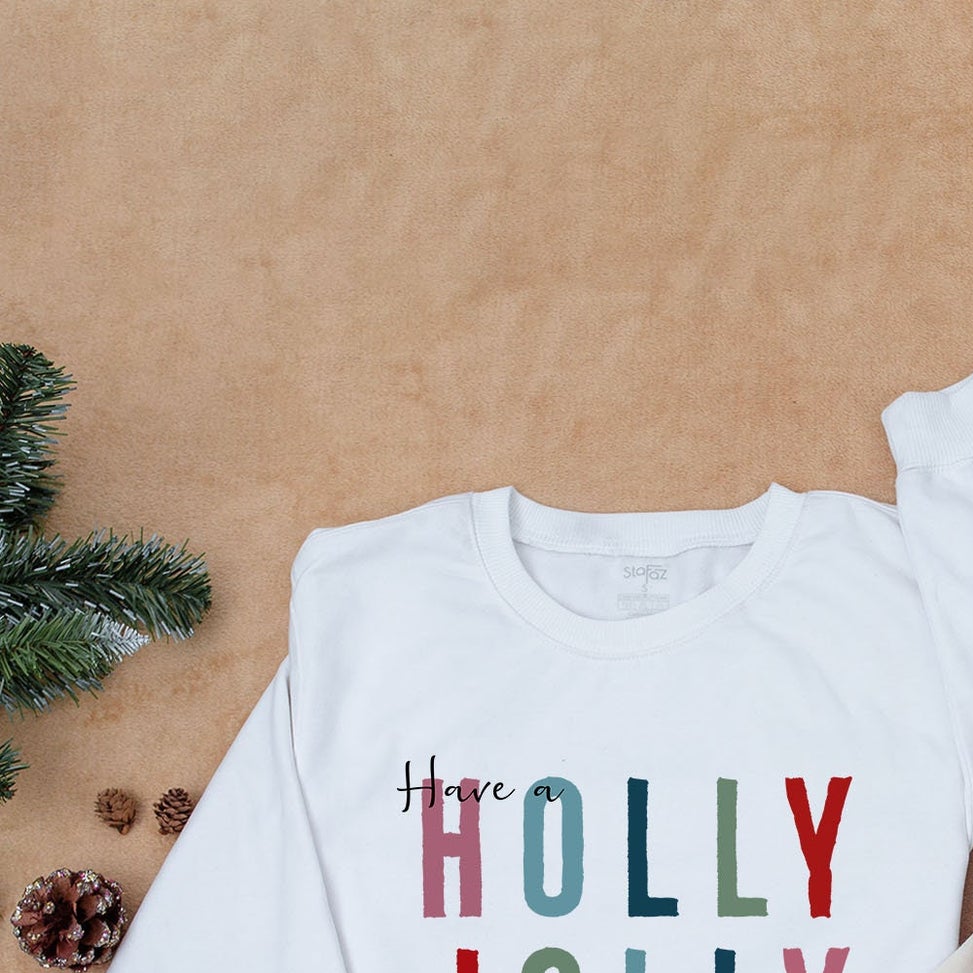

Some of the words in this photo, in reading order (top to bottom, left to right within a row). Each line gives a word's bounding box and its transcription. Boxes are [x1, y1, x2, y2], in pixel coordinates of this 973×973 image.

[397, 755, 515, 813] Have
[533, 783, 565, 804] a
[421, 776, 853, 918] HOLLY
